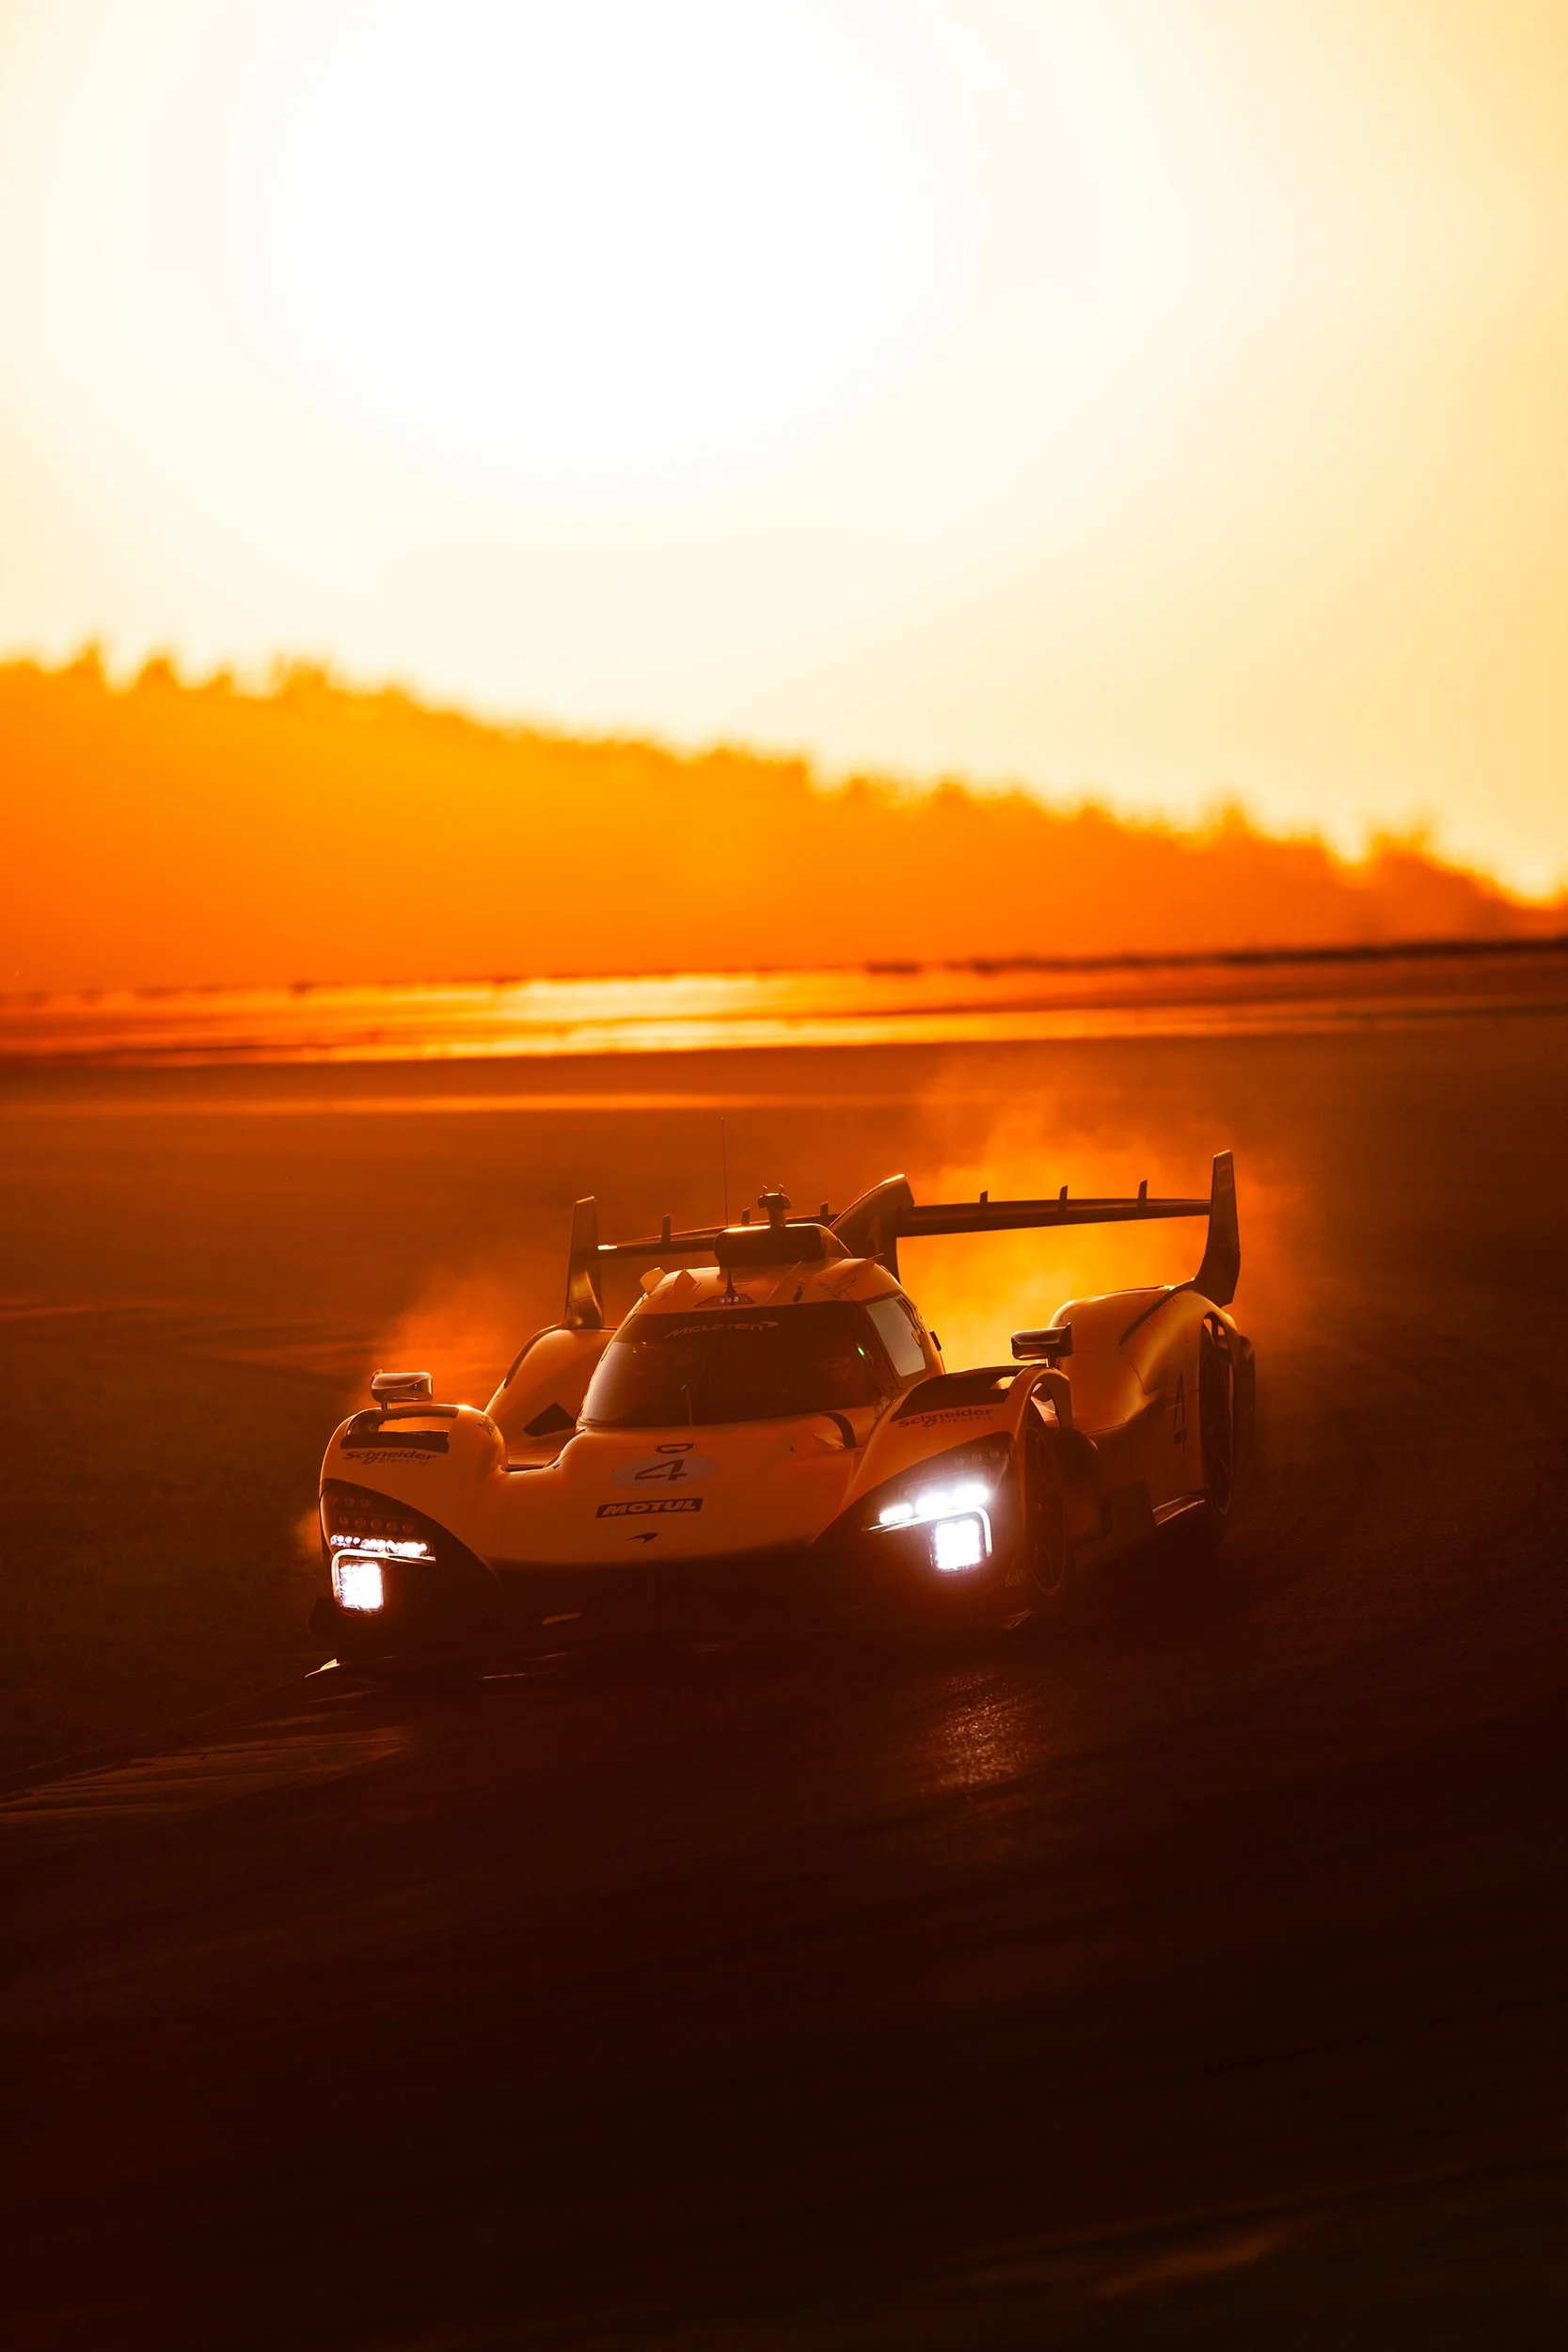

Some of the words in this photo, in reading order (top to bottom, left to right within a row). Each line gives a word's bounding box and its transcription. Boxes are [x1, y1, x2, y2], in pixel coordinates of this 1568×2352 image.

[662, 1322, 764, 1340] McLaren
[896, 1408, 994, 1427] Schneider
[343, 1450, 436, 1465] Schneider
[634, 1459, 688, 1481] 4
[602, 1500, 696, 1516] MOTUL
